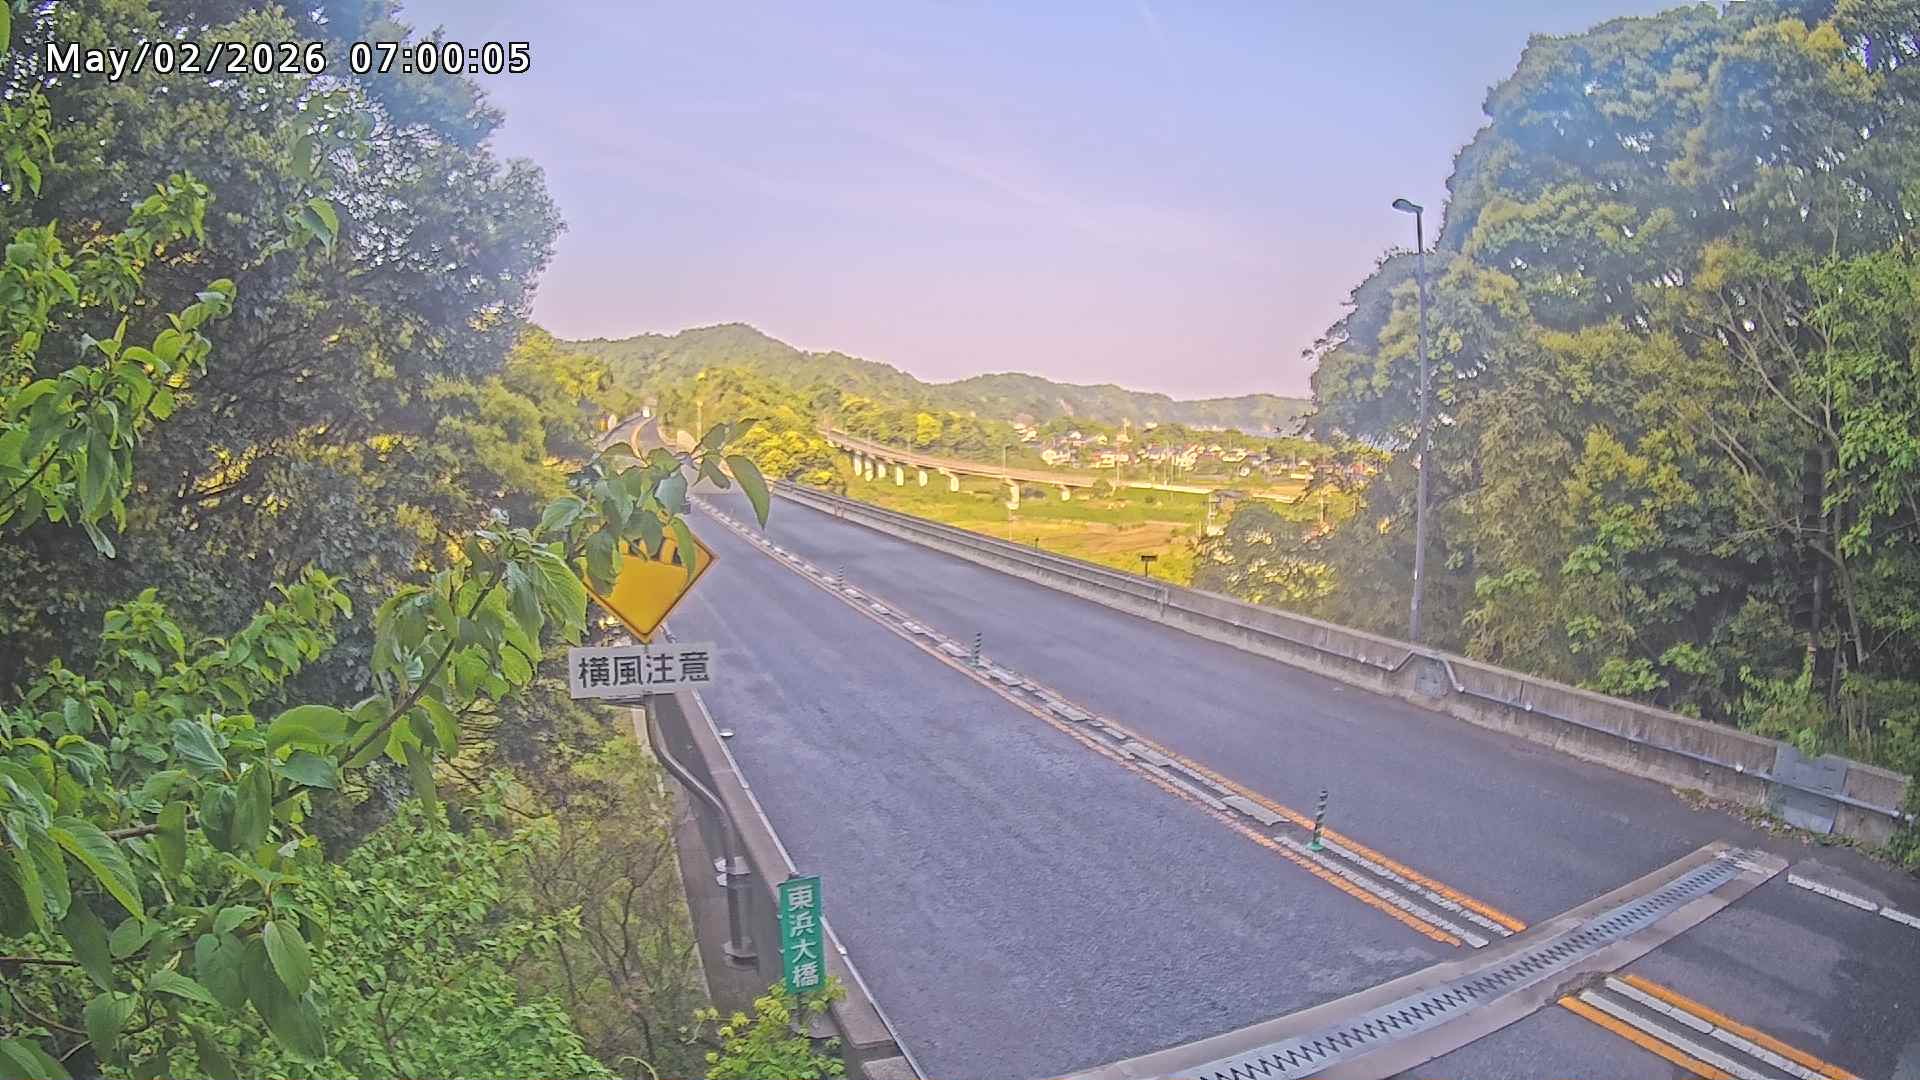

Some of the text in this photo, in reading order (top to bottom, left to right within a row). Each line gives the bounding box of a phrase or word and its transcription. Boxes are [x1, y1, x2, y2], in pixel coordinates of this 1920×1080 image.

[578, 651, 710, 688] 横風注意
[787, 884, 819, 988] 東浜大橋
